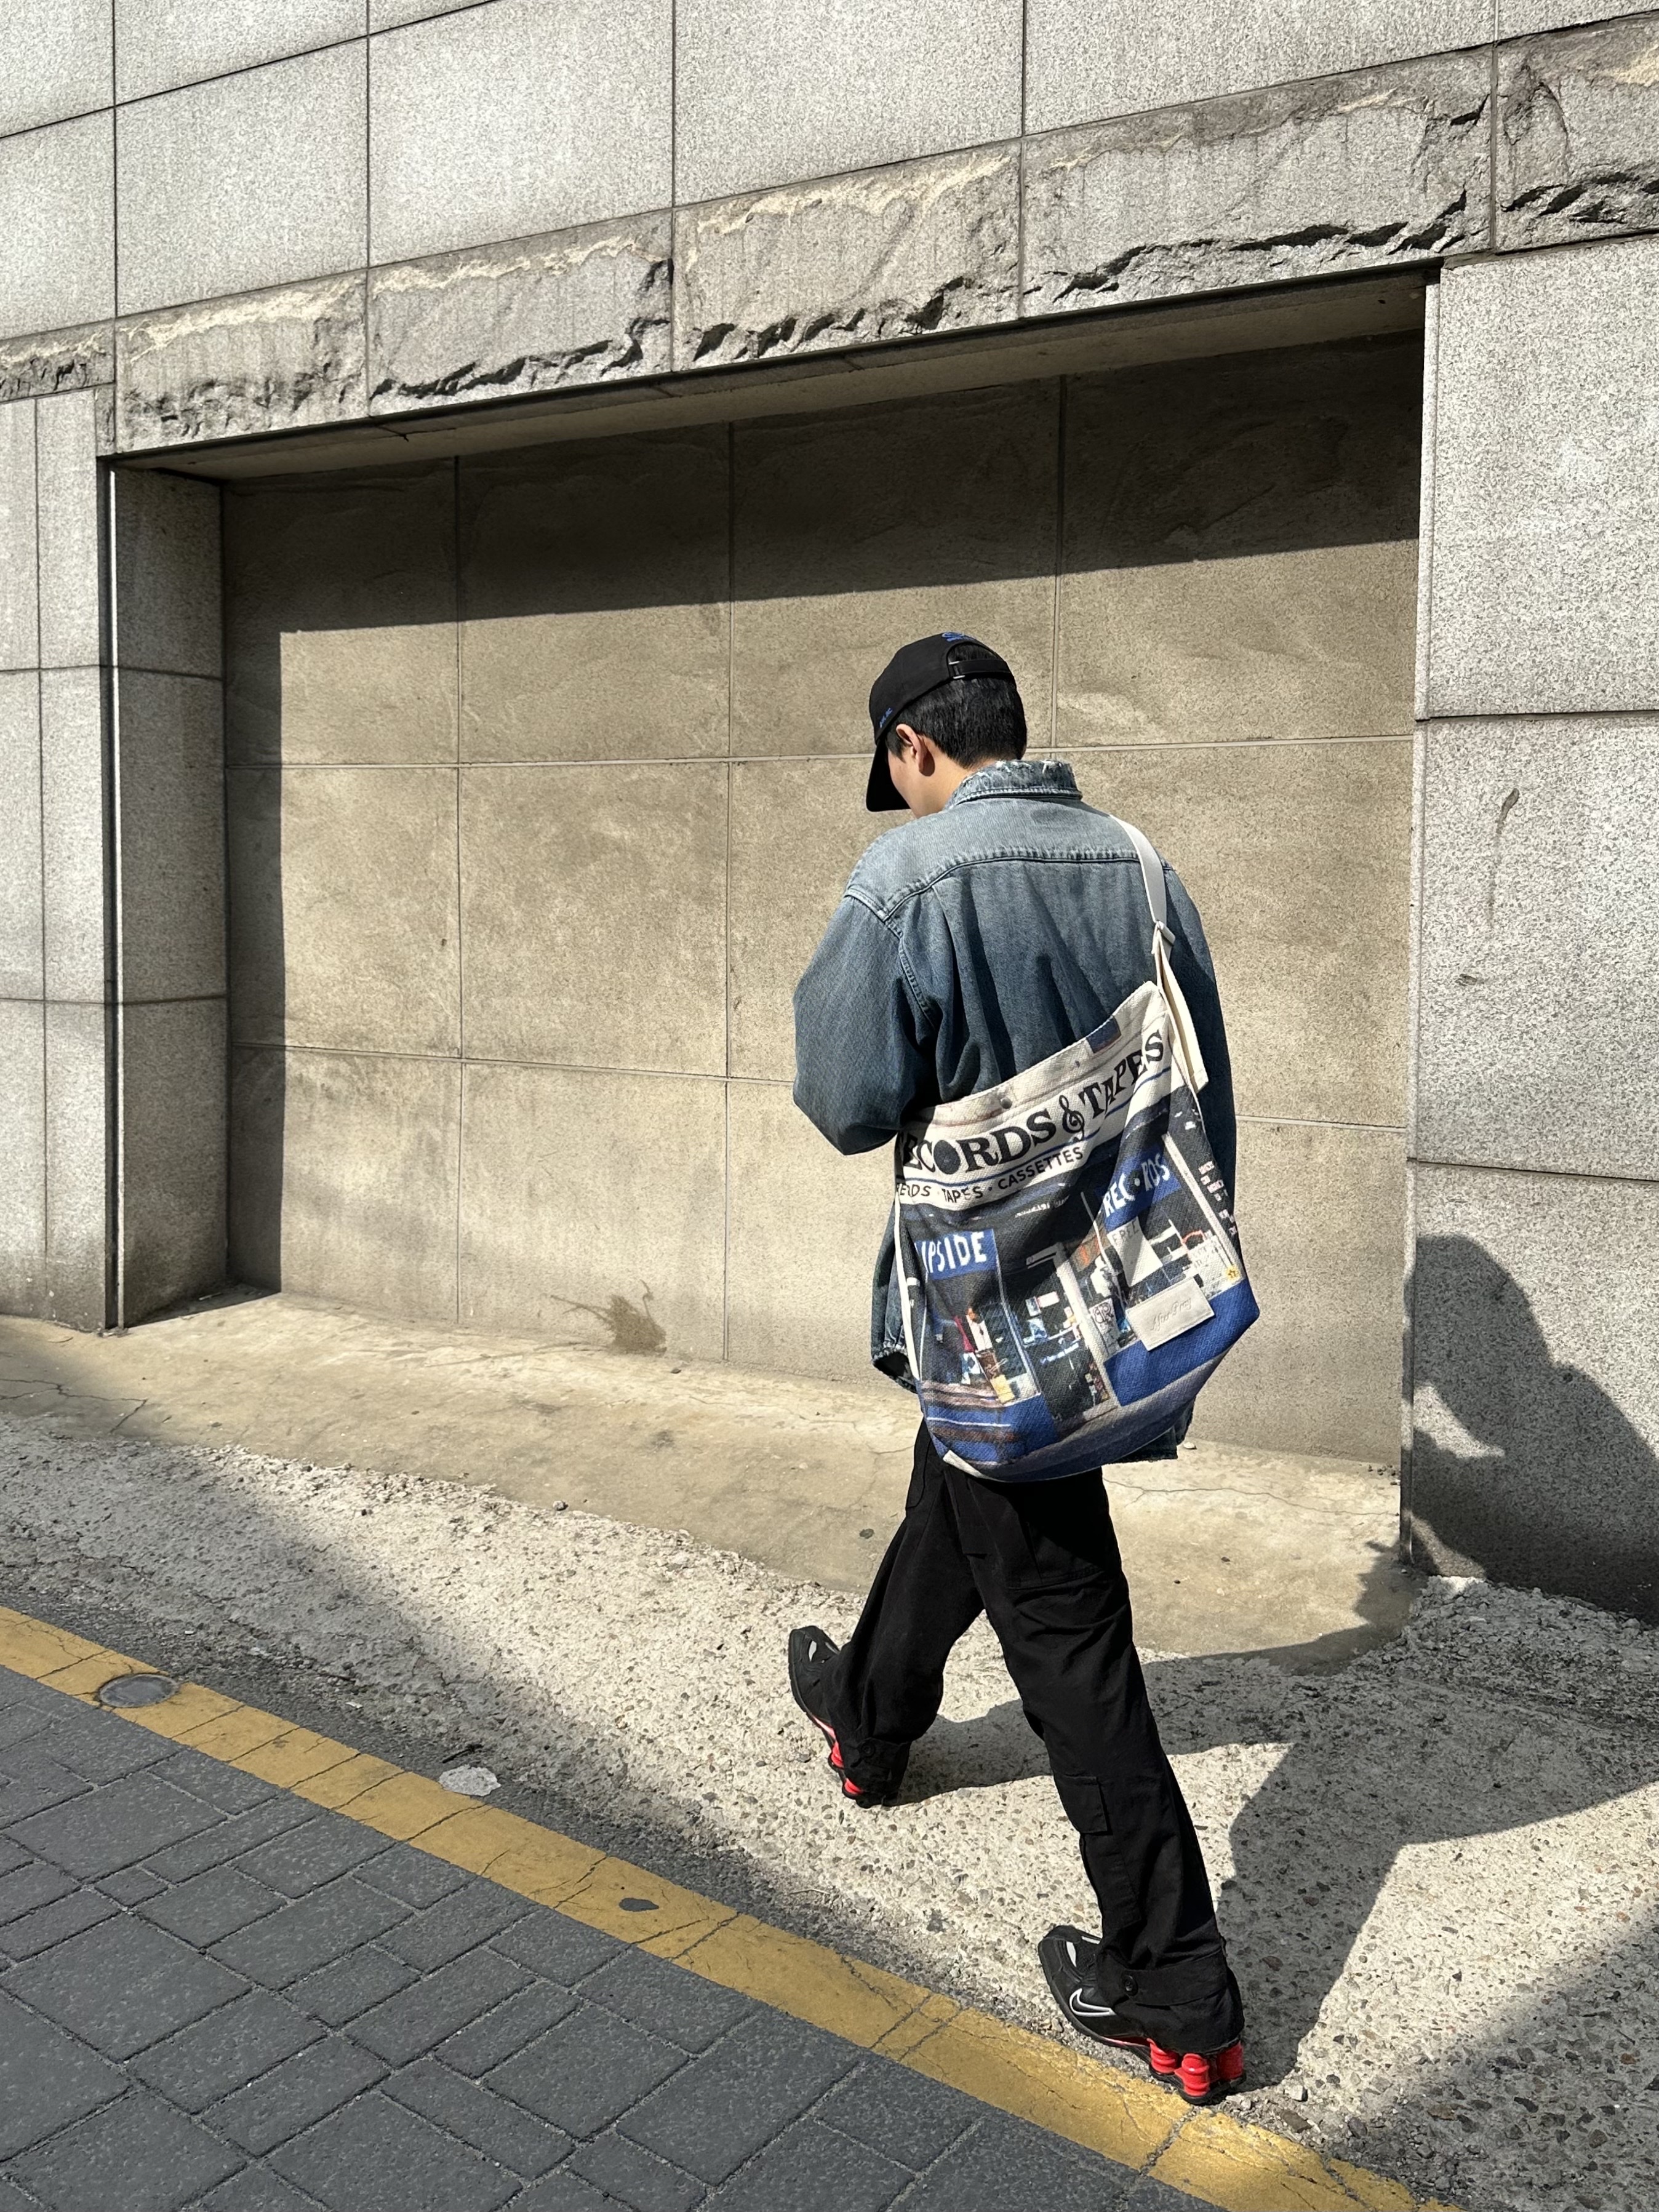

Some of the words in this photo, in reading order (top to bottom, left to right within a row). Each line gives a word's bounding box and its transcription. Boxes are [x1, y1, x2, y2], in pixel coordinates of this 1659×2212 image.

[897, 1108, 1057, 1175] ECORDS
[1078, 1029, 1164, 1120] TAPES
[997, 1146, 1084, 1191] CASSETTES
